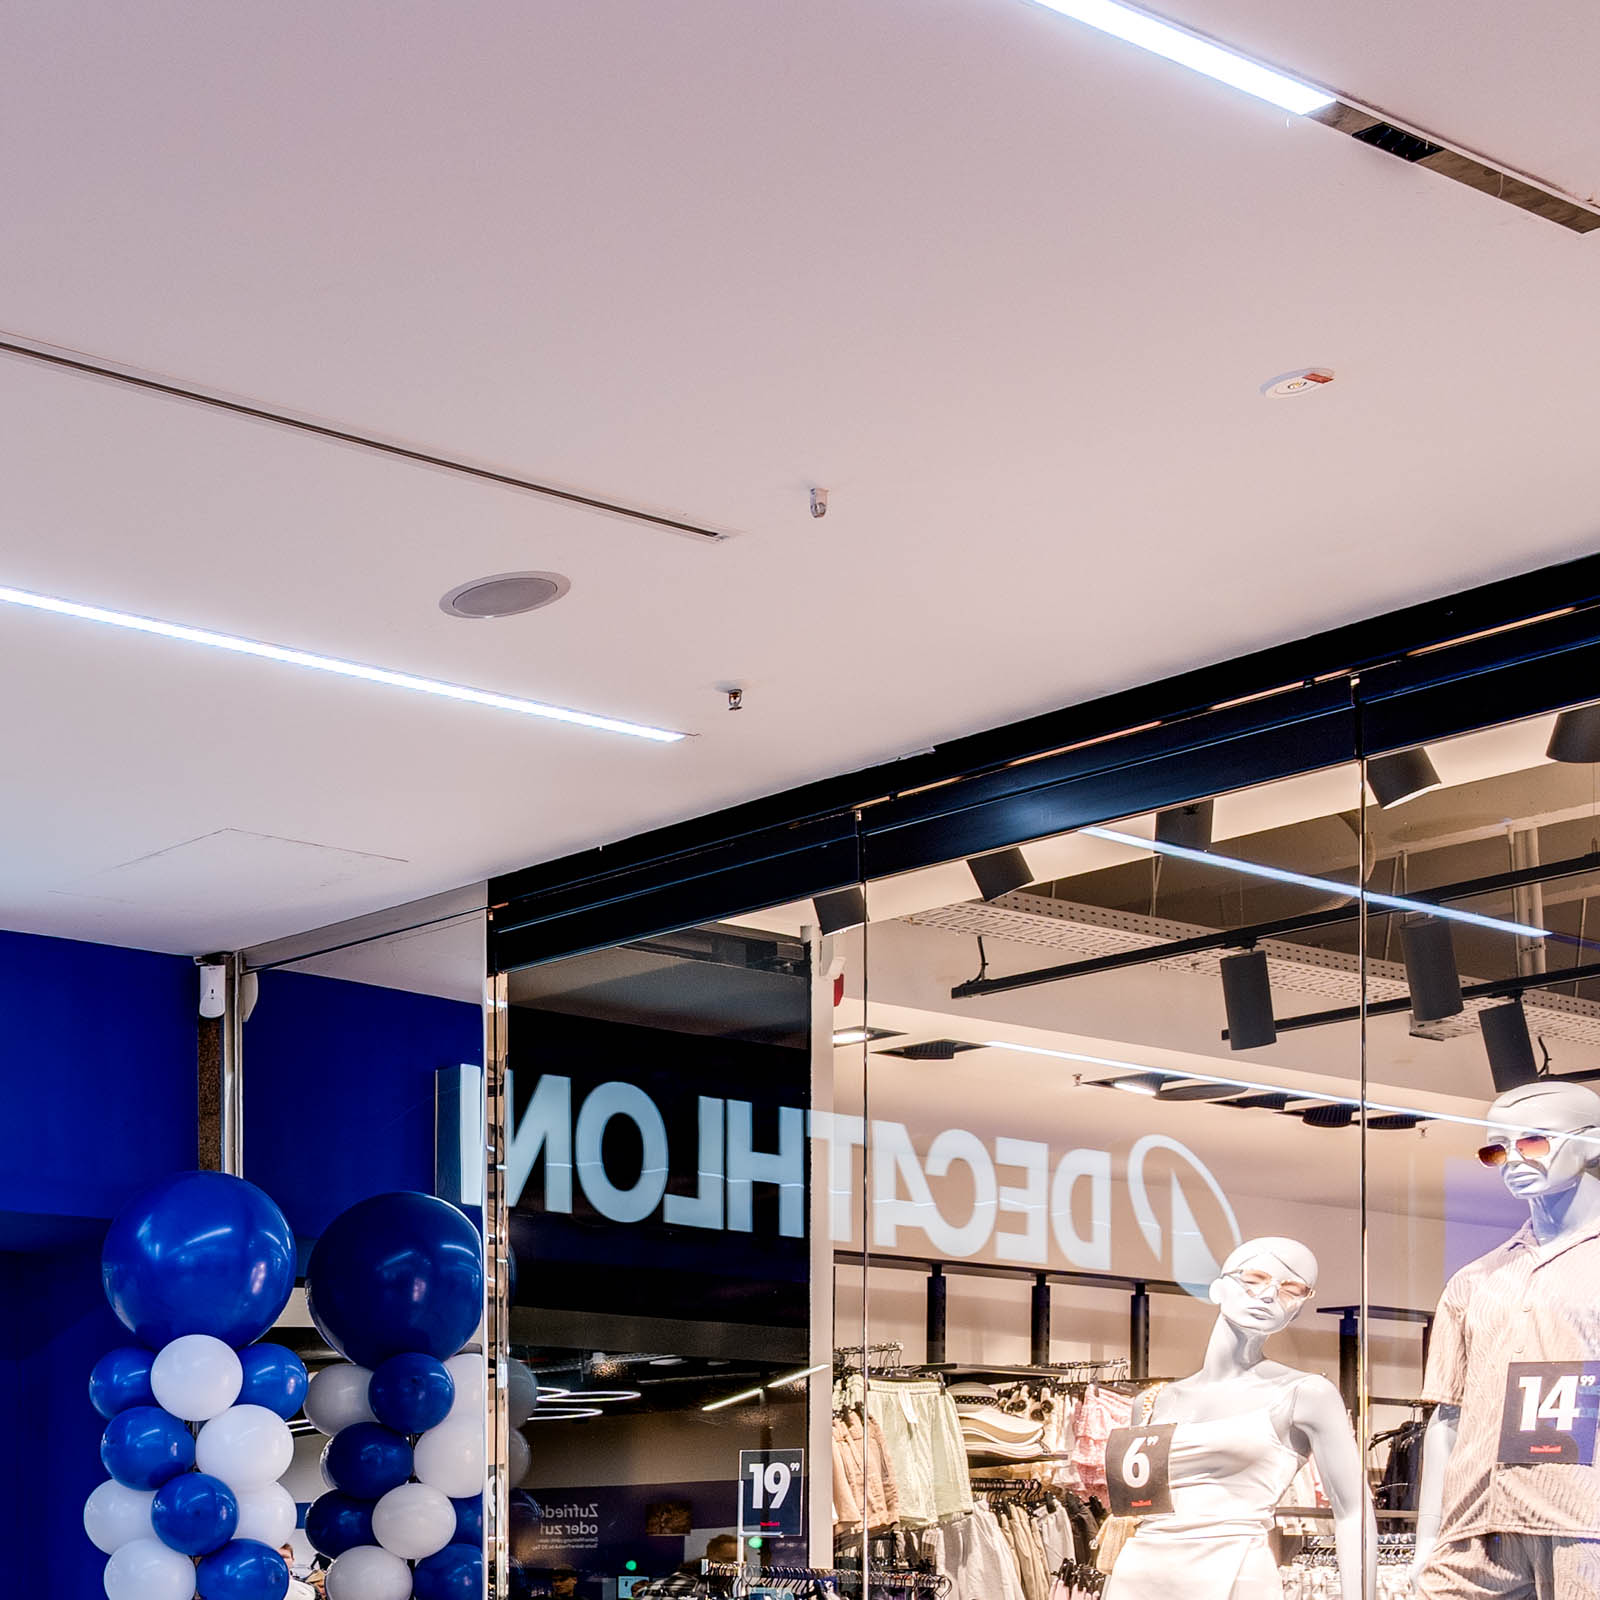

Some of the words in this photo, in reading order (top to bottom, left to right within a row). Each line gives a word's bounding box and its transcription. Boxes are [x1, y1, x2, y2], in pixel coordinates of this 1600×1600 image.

[1518, 1375, 1580, 1431] 14
[1579, 1374, 1597, 1387] 99
[748, 1462, 792, 1509] 19
[790, 1462, 801, 1472] 99
[1122, 1436, 1151, 1489] 6
